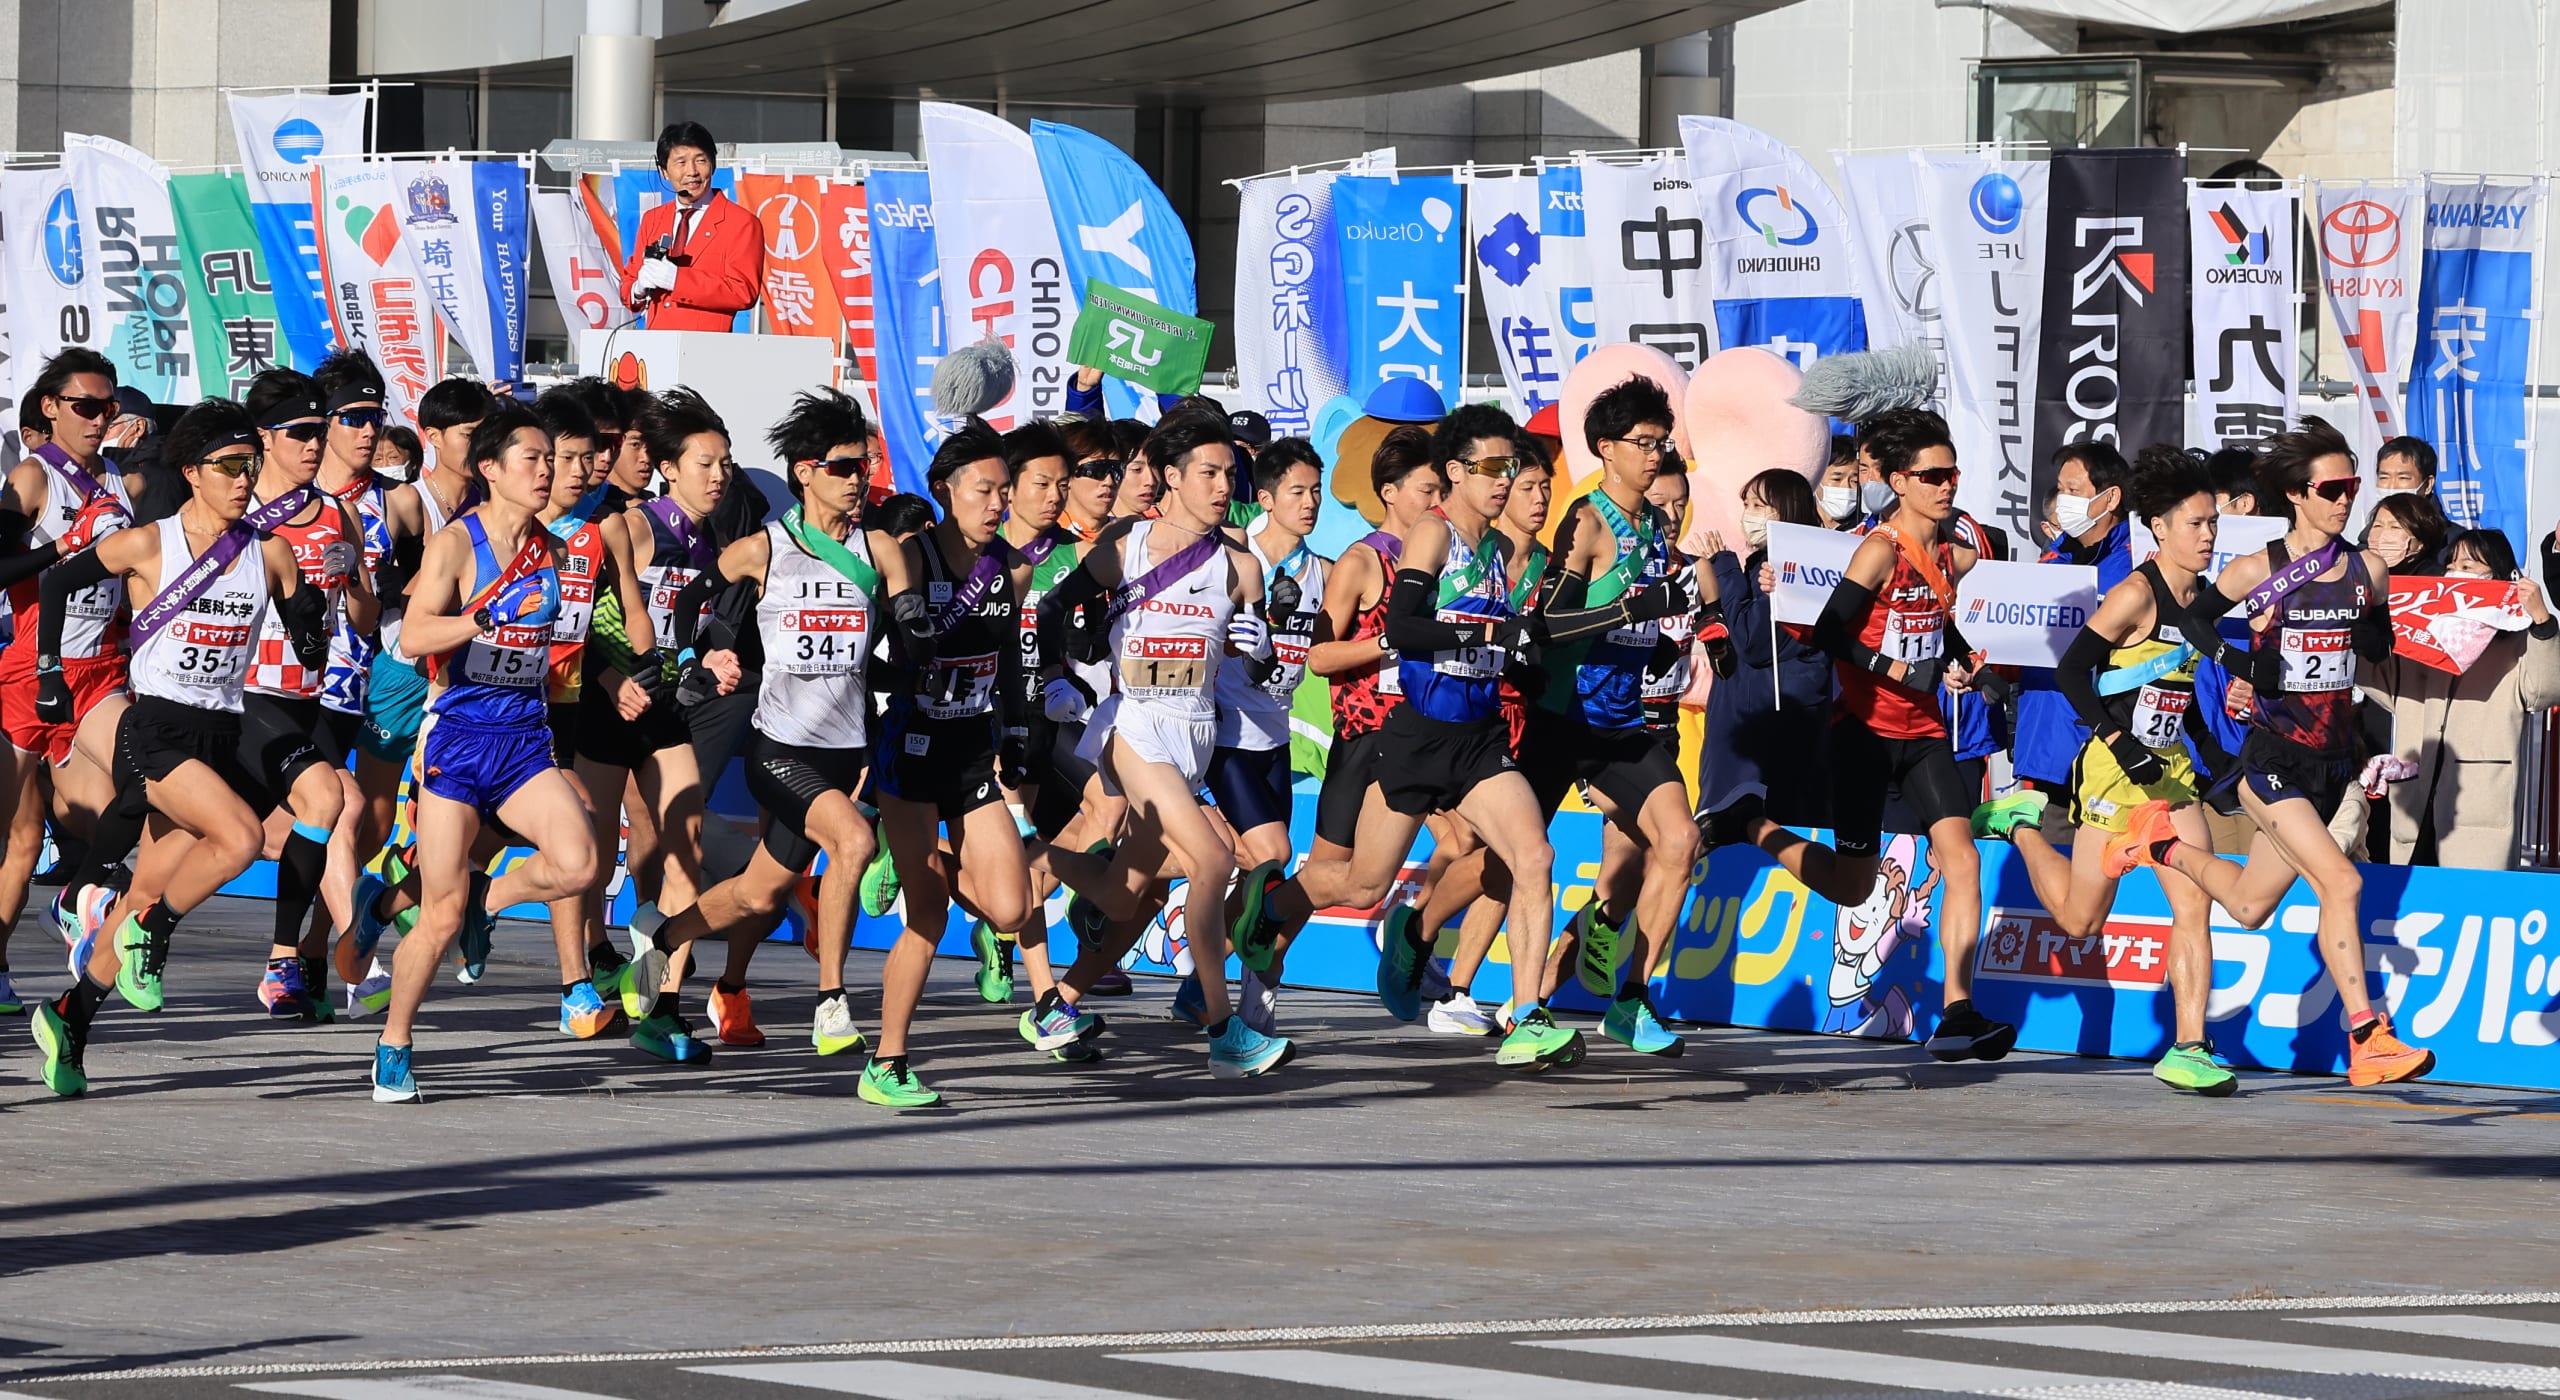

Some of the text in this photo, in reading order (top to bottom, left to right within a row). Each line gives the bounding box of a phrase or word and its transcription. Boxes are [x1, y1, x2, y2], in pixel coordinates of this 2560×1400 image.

[492, 188, 507, 232] Your
[496, 242, 519, 353] HAPPINESS
[225, 591, 254, 599] 2XU
[793, 582, 854, 598] JFE
[2246, 559, 2320, 615] SUBAR
[803, 614, 861, 627] ヤマザキ
[1987, 601, 2086, 629] LOGISTEED
[2289, 609, 2359, 621] SUBARU
[193, 627, 246, 642] ヤマザキ
[503, 630, 549, 644] ヤマザキ
[797, 635, 856, 660] 34-1
[1146, 642, 1202, 654] ヤマザキ
[179, 647, 238, 674] 35-1
[490, 650, 544, 674] 15-1
[2305, 655, 2348, 680] 2-1
[1148, 661, 1193, 685] 1-1
[2036, 928, 2164, 971] ヤマザキ
